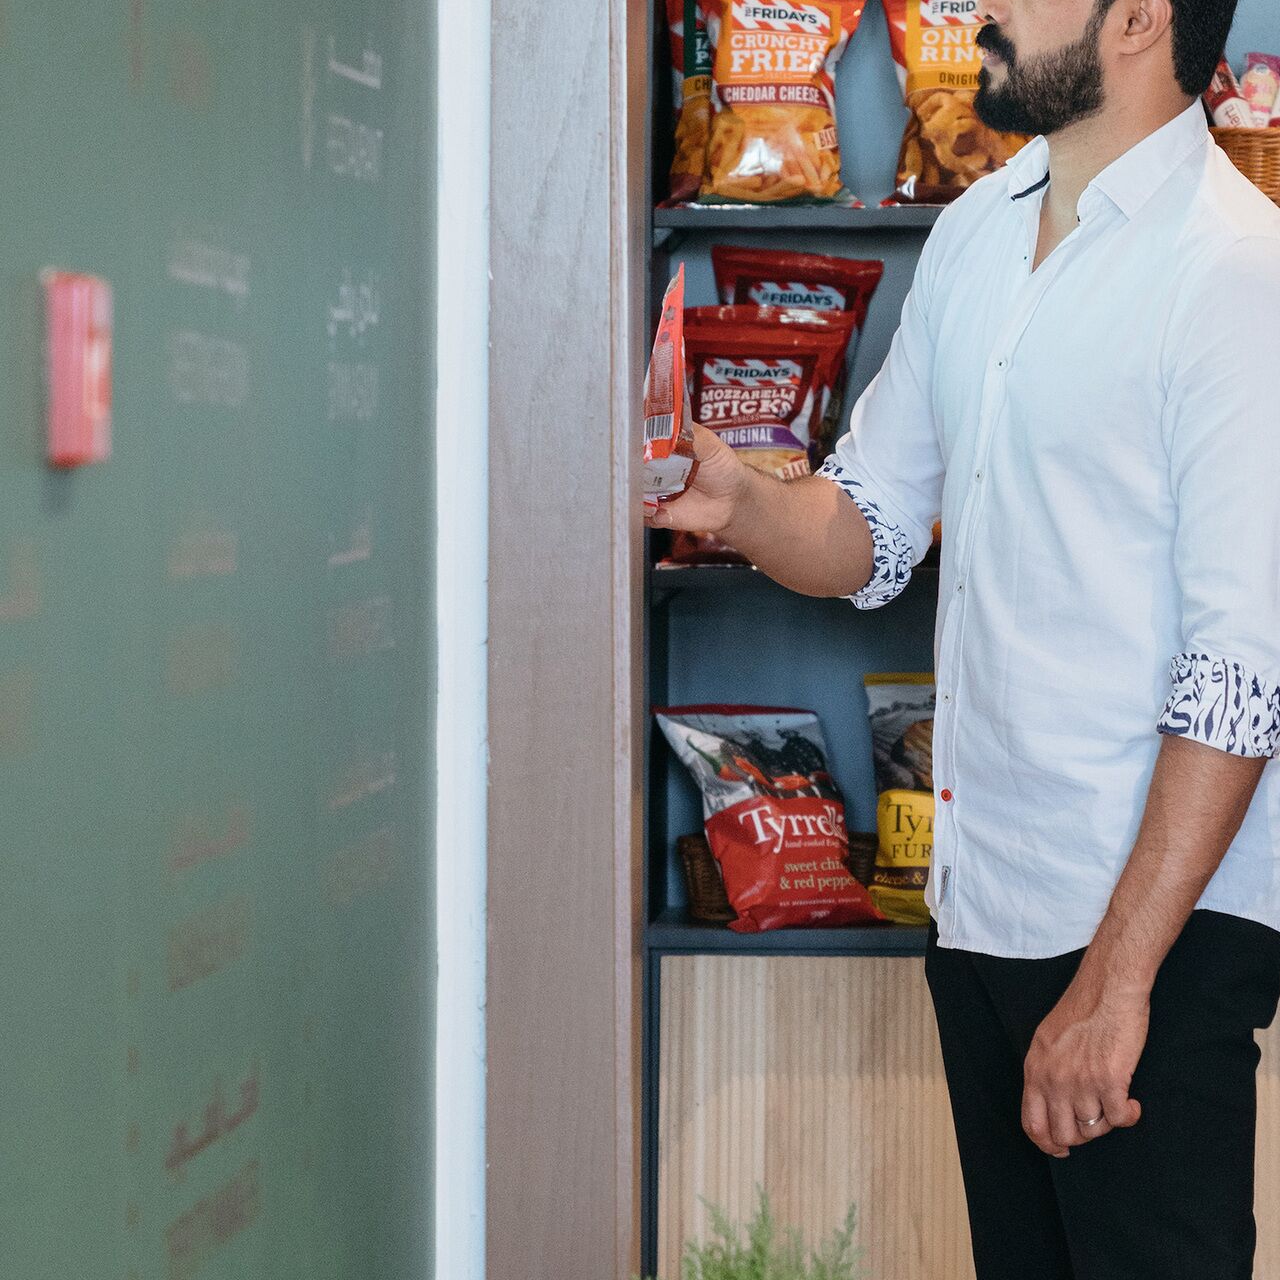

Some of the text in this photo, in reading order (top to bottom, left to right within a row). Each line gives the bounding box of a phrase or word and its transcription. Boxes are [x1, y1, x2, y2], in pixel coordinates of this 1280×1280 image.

[940, 1, 976, 14] FRID
[752, 8, 817, 24] FRIDAYS
[730, 34, 829, 52] CRUNCHY
[922, 29, 974, 45] ONI
[730, 49, 826, 73] FRIES
[921, 46, 975, 62] RIN
[725, 87, 820, 103] CHEDDAR CHEESE
[771, 293, 833, 306] FRIDAYS
[725, 367, 790, 378] FRIDAYS
[701, 387, 796, 404] MOZZARELLA
[700, 399, 793, 420] STICKS
[720, 427, 774, 445] ORIGINAL
[784, 857, 844, 873] sweet chi
[780, 875, 856, 892] & red peppe
